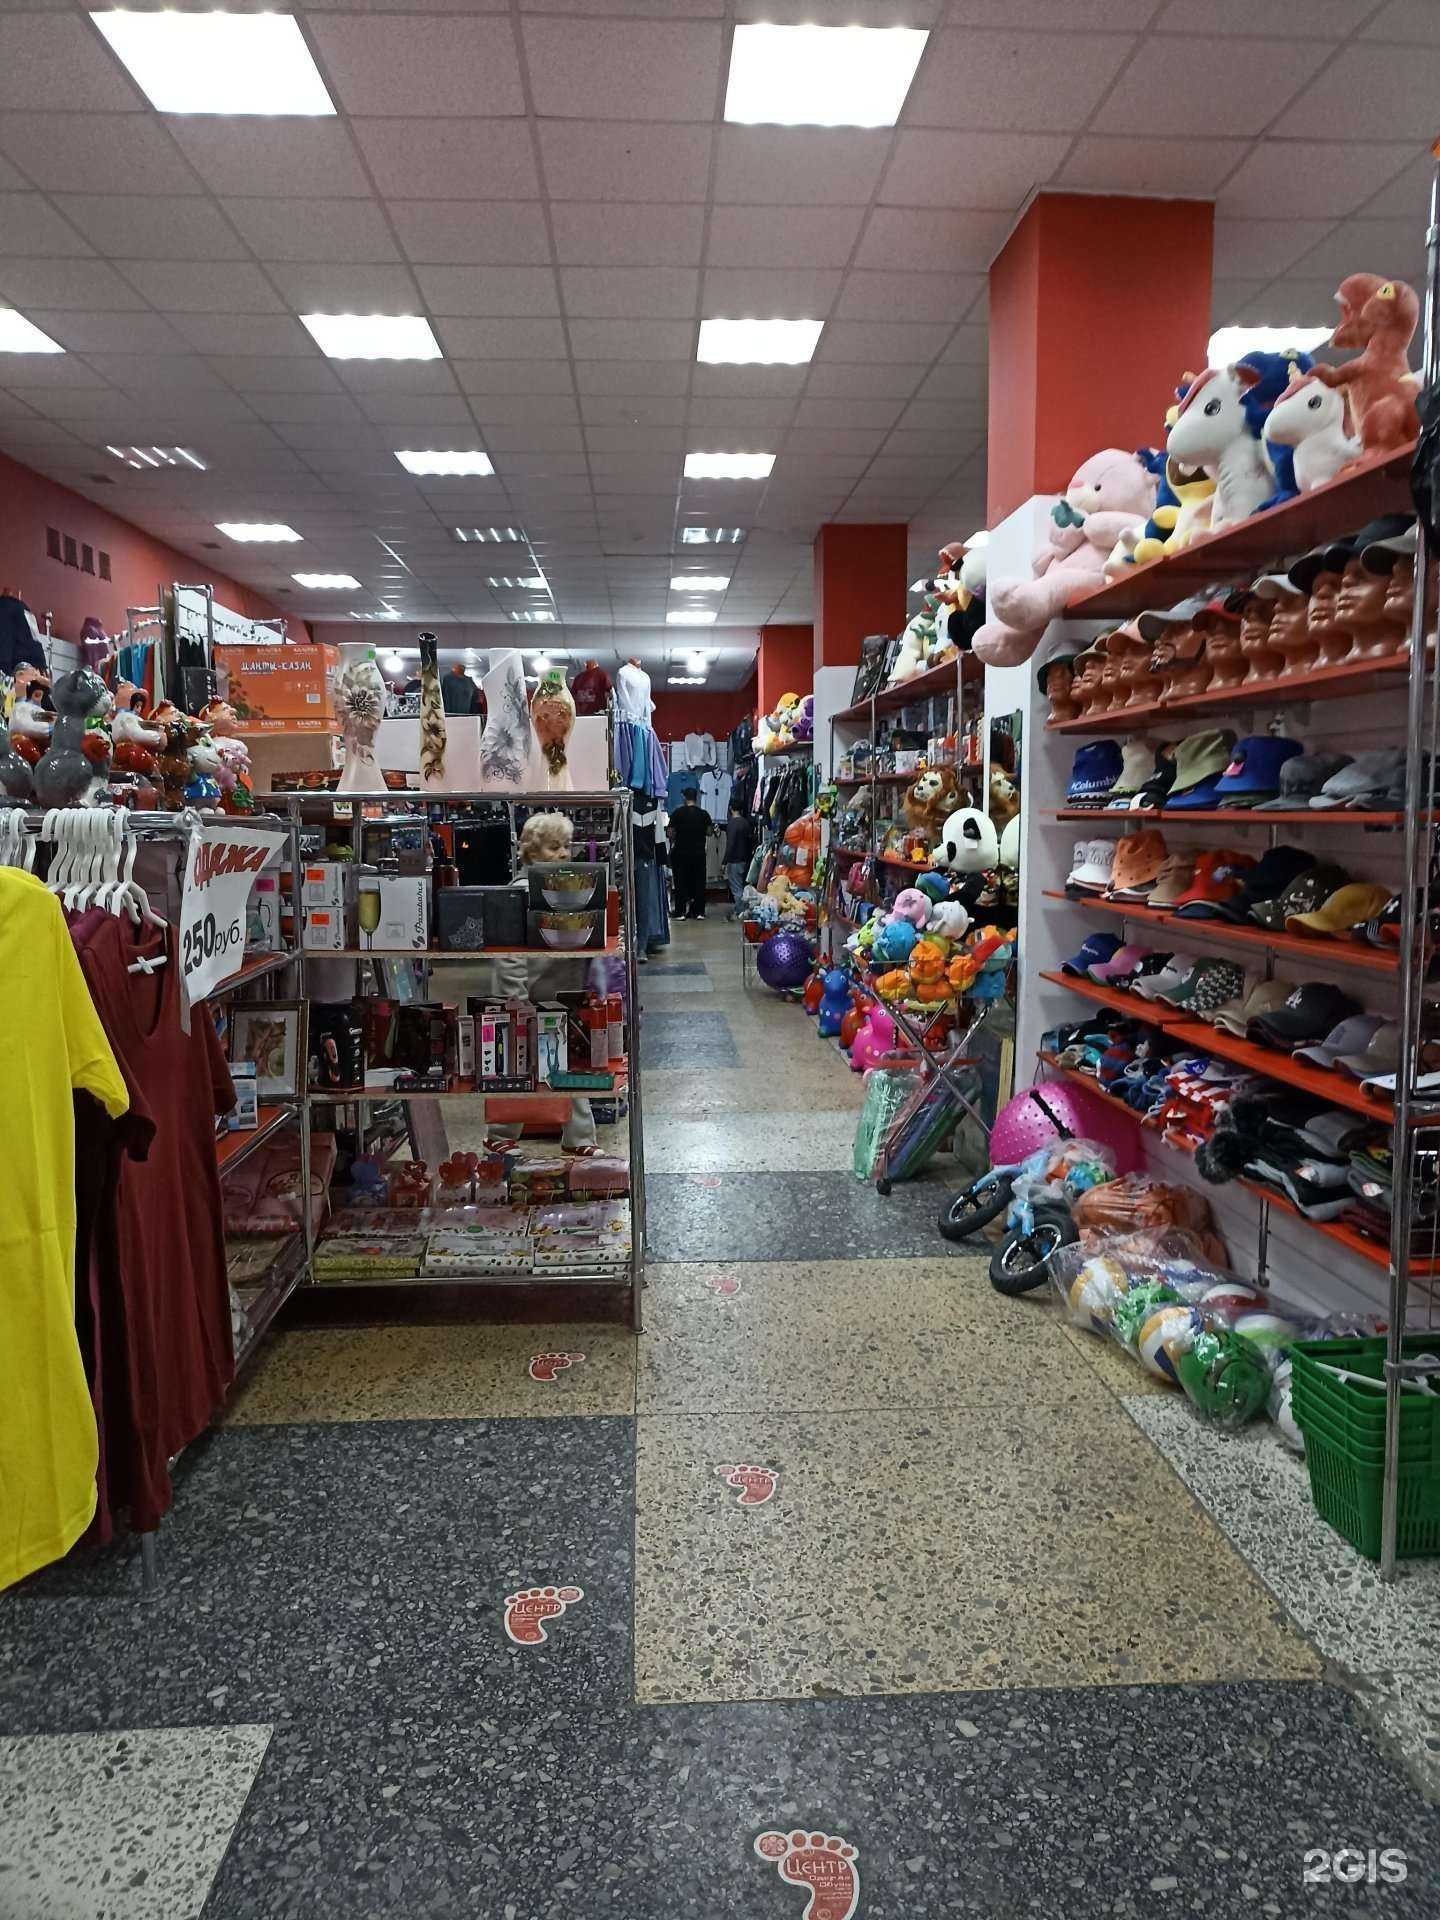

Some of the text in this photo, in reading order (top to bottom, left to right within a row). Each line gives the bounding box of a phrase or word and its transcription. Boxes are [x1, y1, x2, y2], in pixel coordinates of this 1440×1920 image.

[1074, 775, 1119, 791] Columbi
[514, 1603, 560, 1613] ЦЕНТР
[786, 1858, 848, 1876] ЦЕНТР
